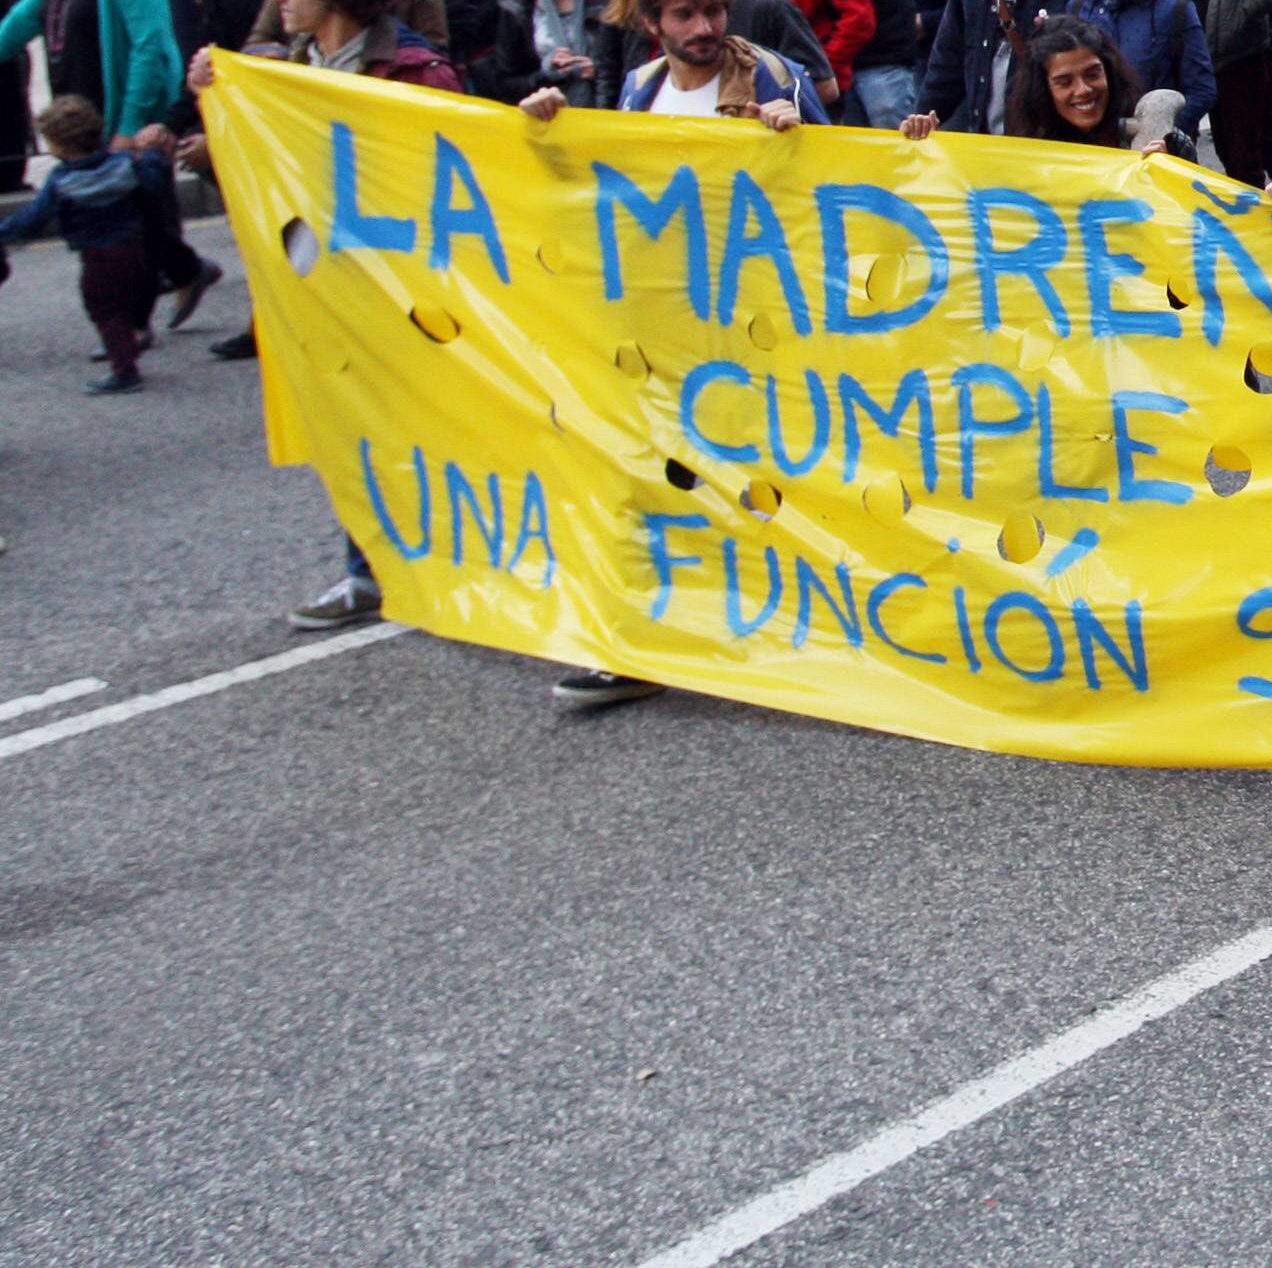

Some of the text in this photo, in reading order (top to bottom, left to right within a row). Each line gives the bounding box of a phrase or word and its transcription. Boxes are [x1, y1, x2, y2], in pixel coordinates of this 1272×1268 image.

[330, 122, 510, 284] LA
[680, 360, 1194, 505] CUMPLE
[361, 438, 556, 587] UNA
